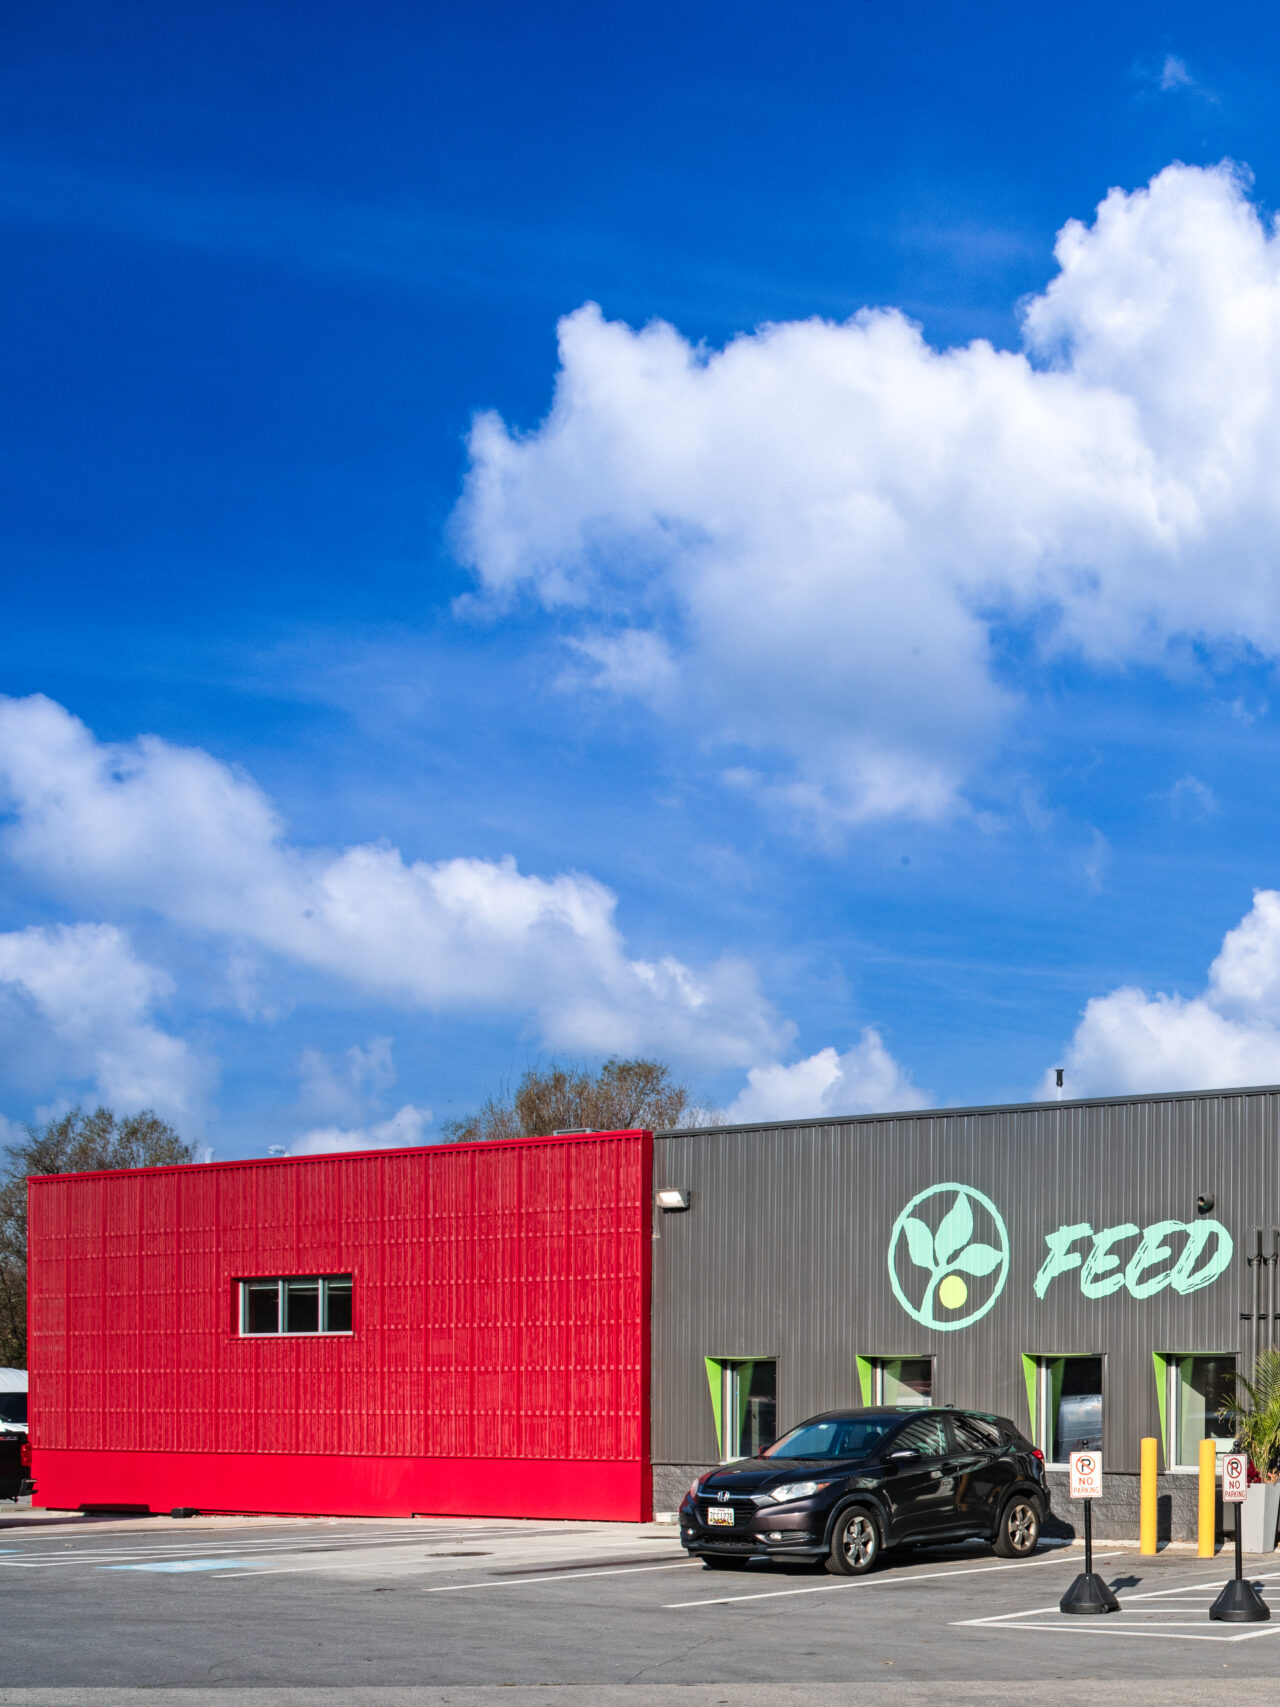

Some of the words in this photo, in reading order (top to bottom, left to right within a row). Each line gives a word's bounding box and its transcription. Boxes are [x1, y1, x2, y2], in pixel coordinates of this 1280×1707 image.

[1034, 1220, 1233, 1299] FEED
[1078, 1476, 1094, 1486] NO
[1229, 1480, 1241, 1489] NO
[1224, 1490, 1246, 1498] PARKING
